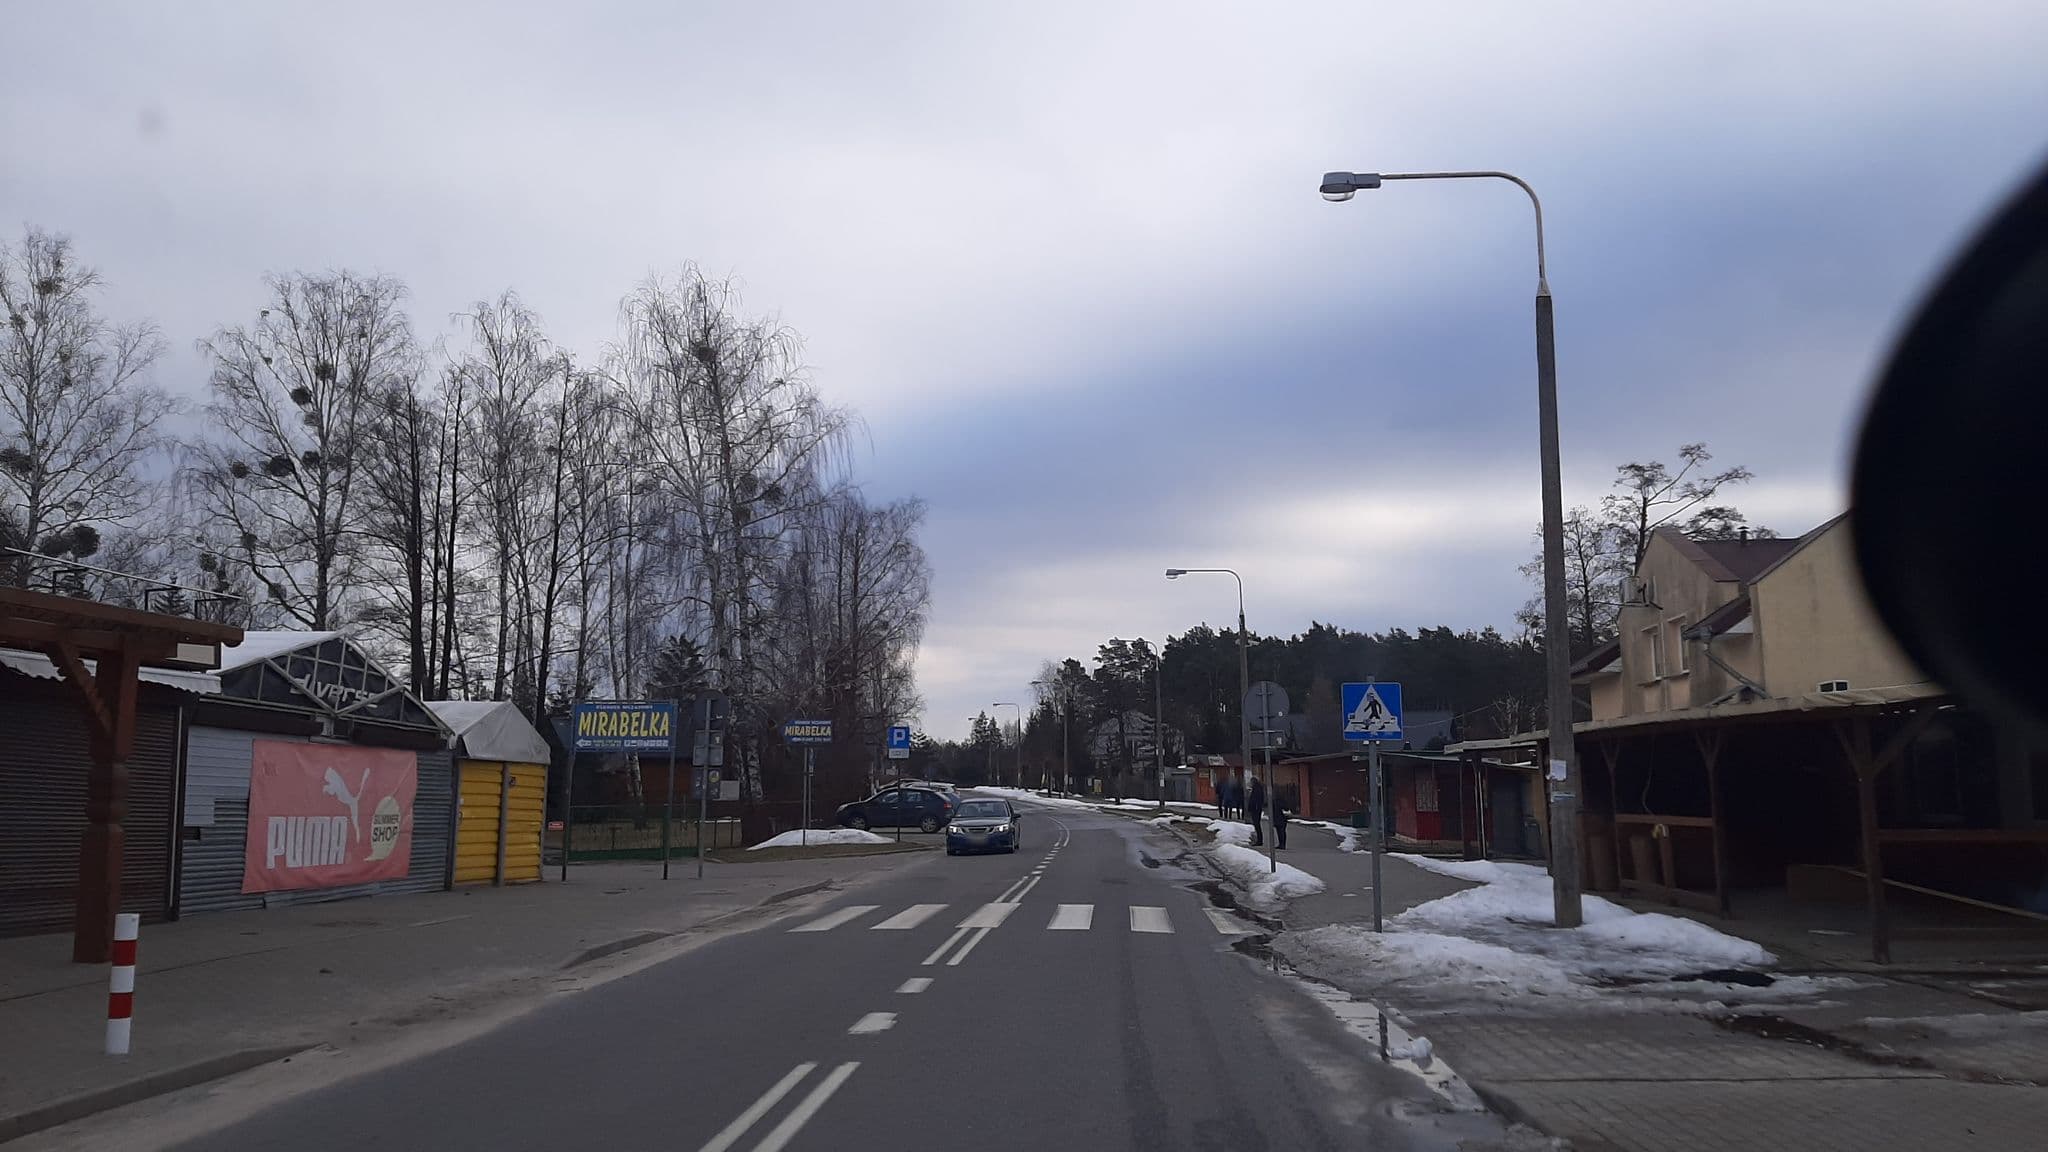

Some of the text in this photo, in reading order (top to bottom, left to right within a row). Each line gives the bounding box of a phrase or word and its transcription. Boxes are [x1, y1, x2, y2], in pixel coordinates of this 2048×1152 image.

[579, 712, 669, 737] MIRABELKA
[785, 726, 832, 737] MIRABELKA
[893, 729, 906, 745] P
[373, 814, 399, 825] SUMMER
[372, 826, 398, 842] SHOP
[267, 816, 349, 869] PUMA
